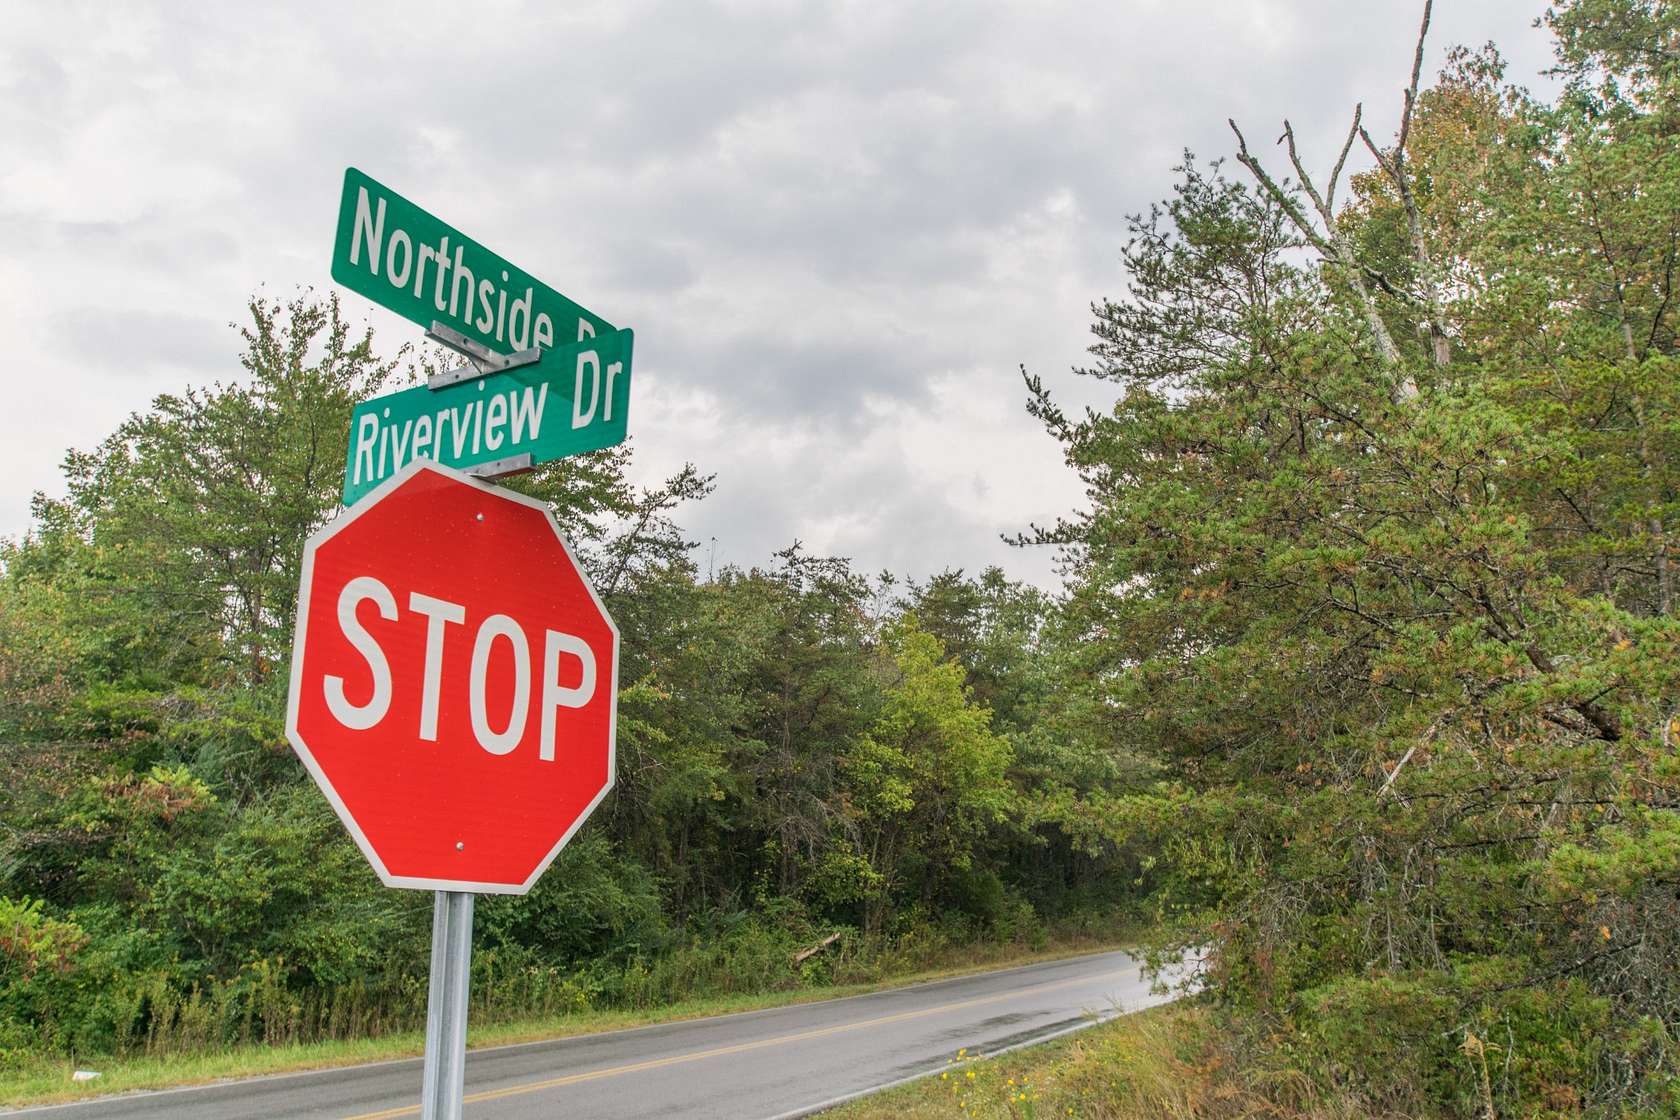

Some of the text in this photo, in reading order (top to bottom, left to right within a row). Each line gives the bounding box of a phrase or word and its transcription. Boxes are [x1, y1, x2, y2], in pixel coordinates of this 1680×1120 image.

[350, 186, 553, 352] Northside
[353, 350, 622, 485] Riverview Dr
[323, 576, 597, 762] STOP
